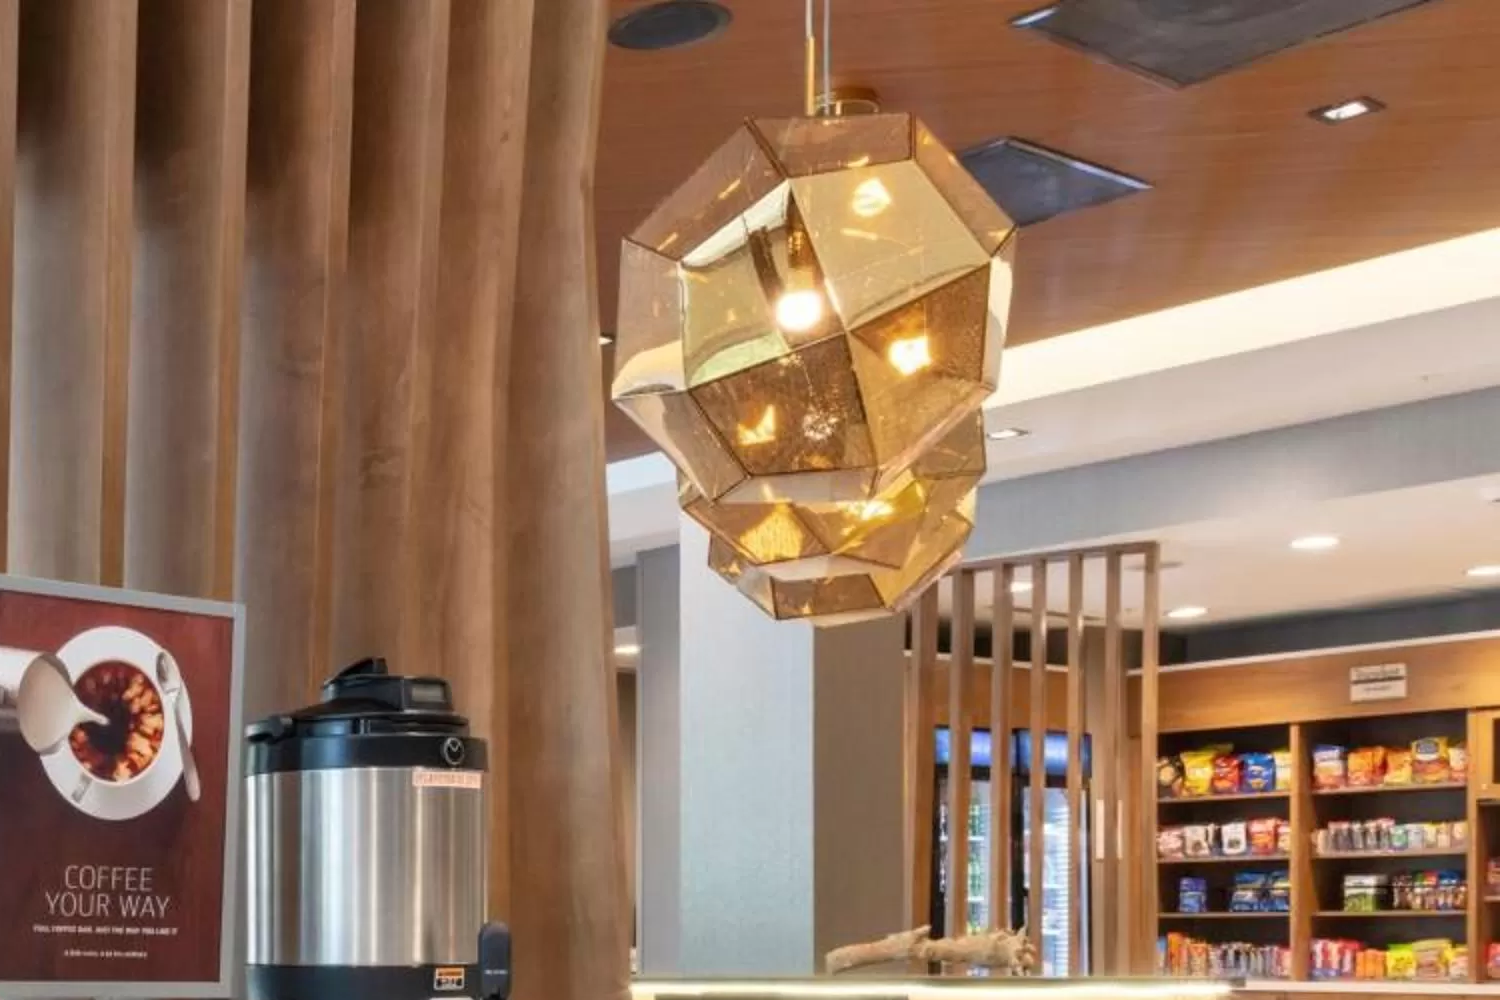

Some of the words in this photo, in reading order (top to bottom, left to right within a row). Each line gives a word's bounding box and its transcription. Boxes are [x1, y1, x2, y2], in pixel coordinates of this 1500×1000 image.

[64, 864, 153, 892] COFFEE
[45, 891, 110, 917] YOUR
[118, 895, 172, 918] WAY
